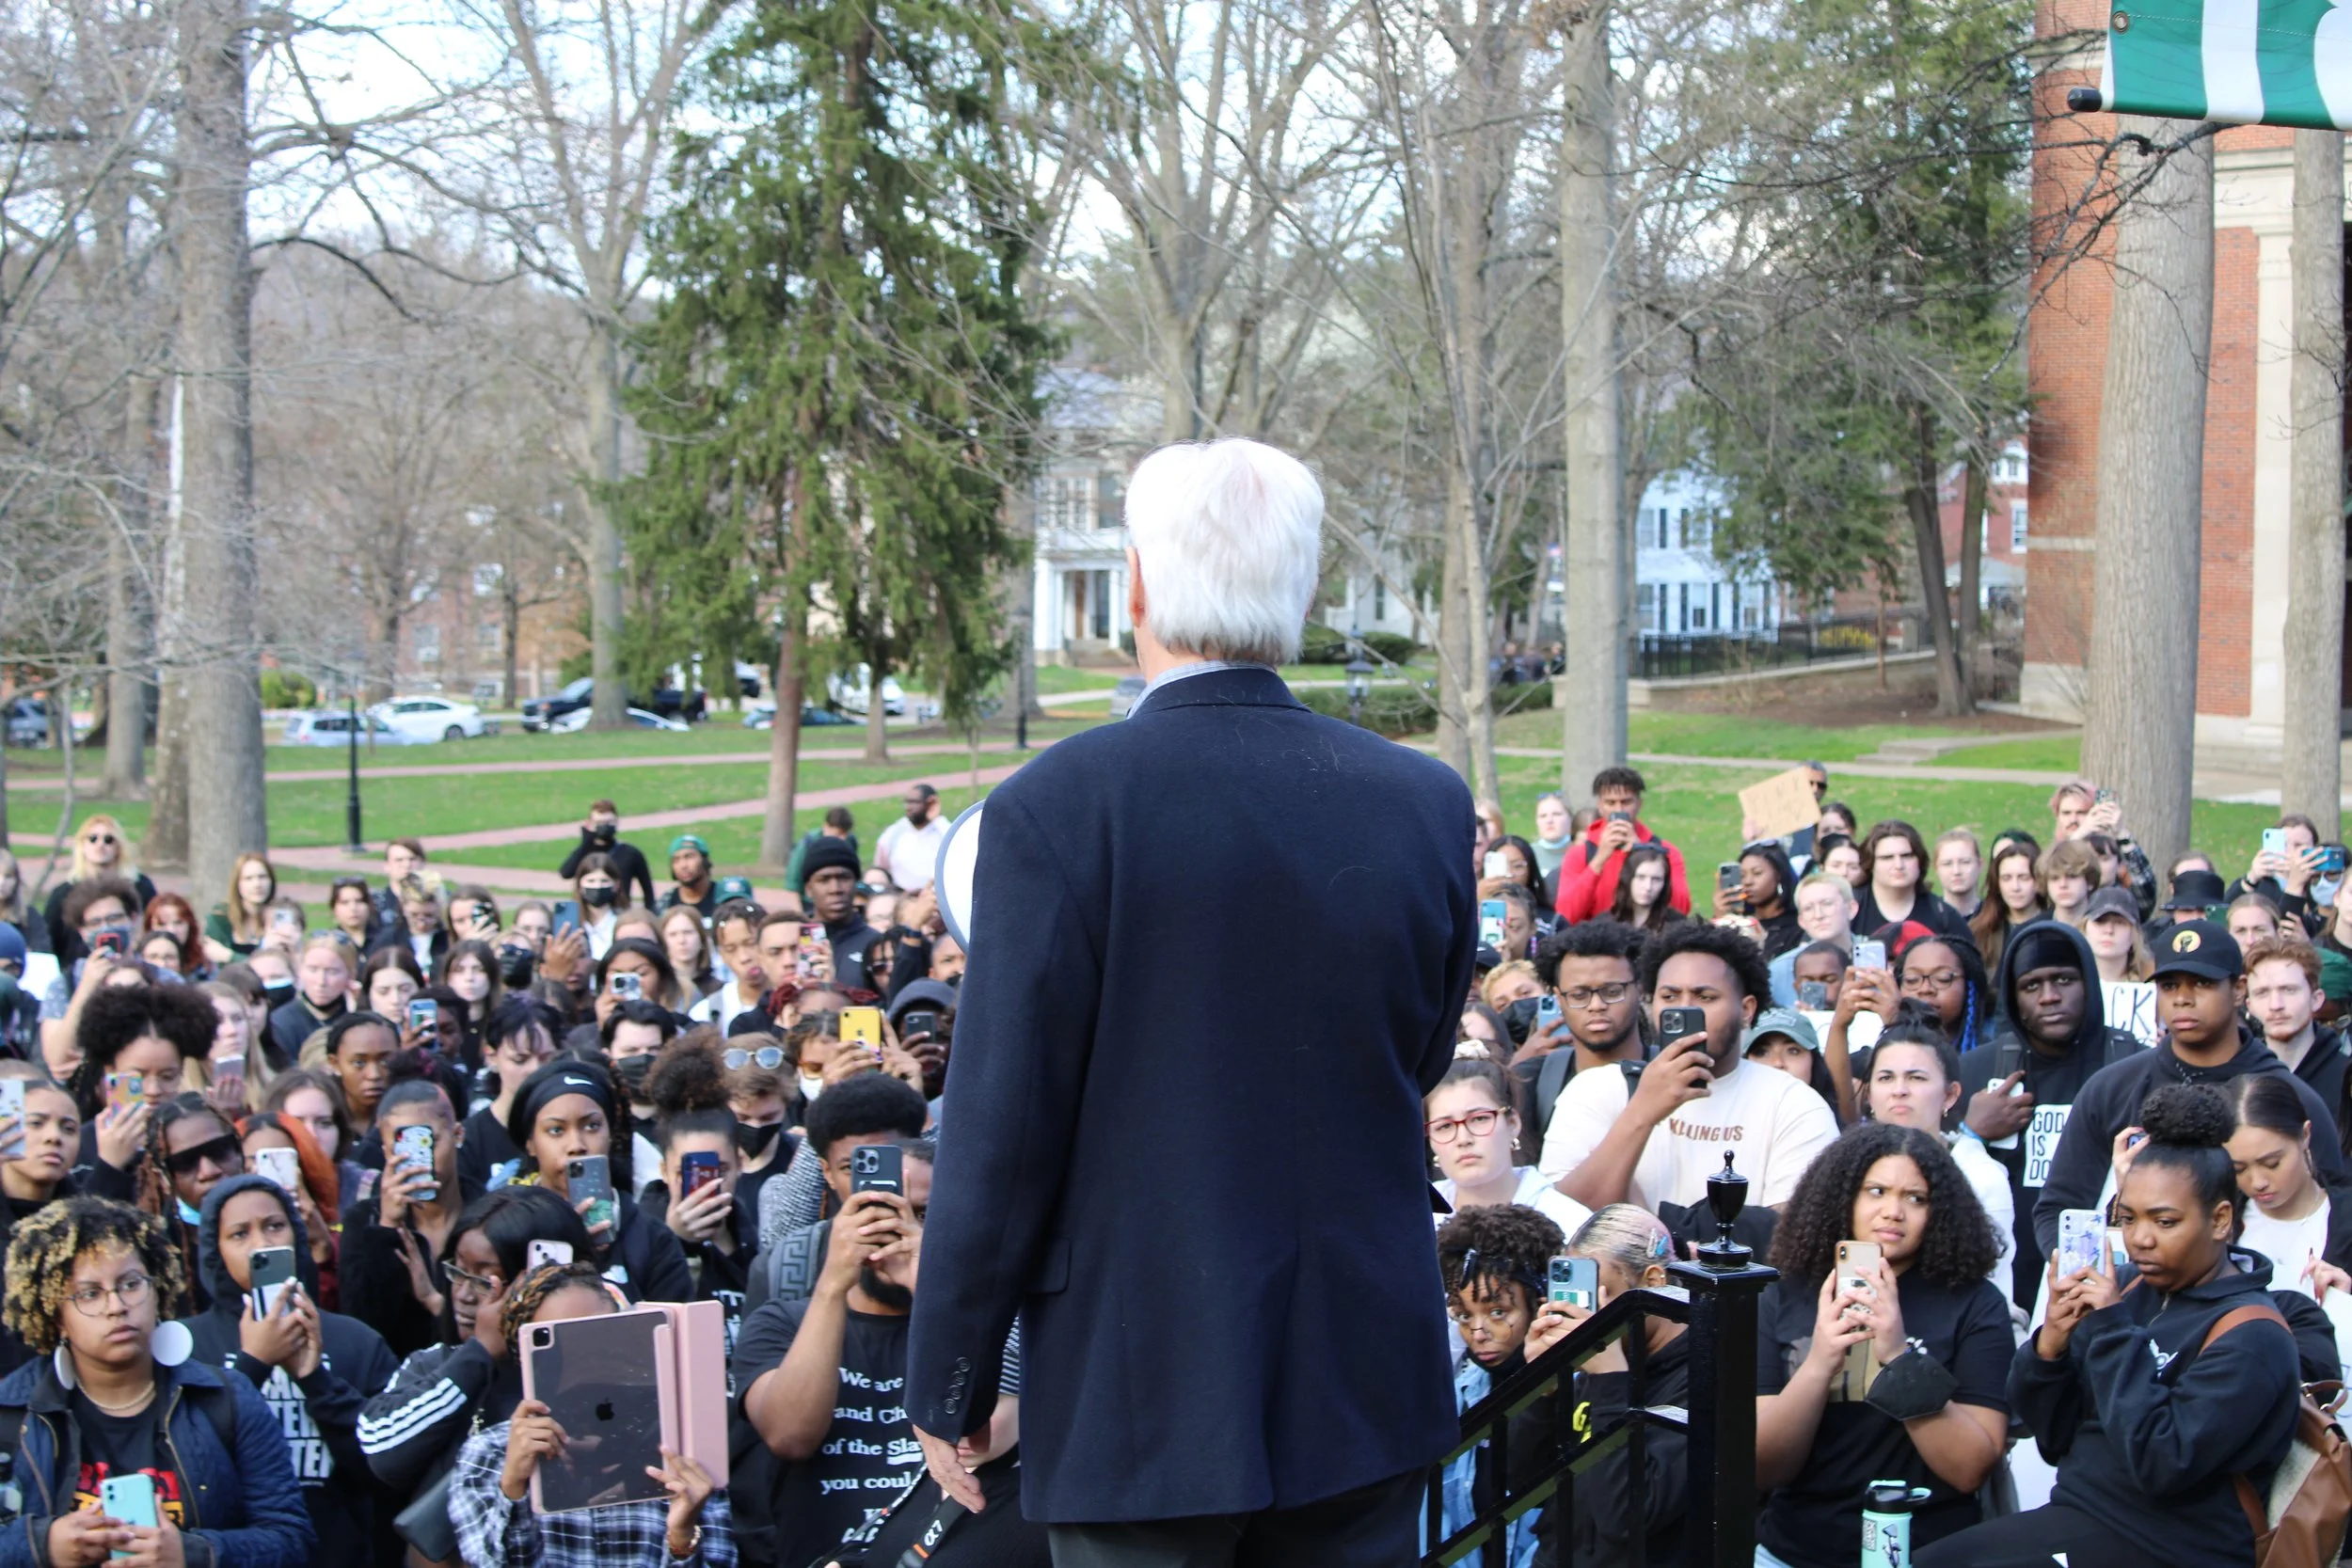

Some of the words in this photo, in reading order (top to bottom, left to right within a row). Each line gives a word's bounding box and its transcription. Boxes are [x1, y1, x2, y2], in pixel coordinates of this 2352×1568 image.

[2033, 1112, 2065, 1133] GOD
[1723, 1125, 1743, 1142] US
[2032, 1134, 2046, 1157] IS
[2029, 1159, 2052, 1180] DO
[838, 1367, 871, 1388] We
[874, 1377, 904, 1392] are
[834, 1406, 874, 1422] and
[878, 1405, 909, 1424] Ch
[821, 1438, 847, 1455] of
[848, 1438, 883, 1455] the
[886, 1437, 923, 1456] Sla
[819, 1478, 859, 1495] you
[864, 1471, 912, 1488] coul
